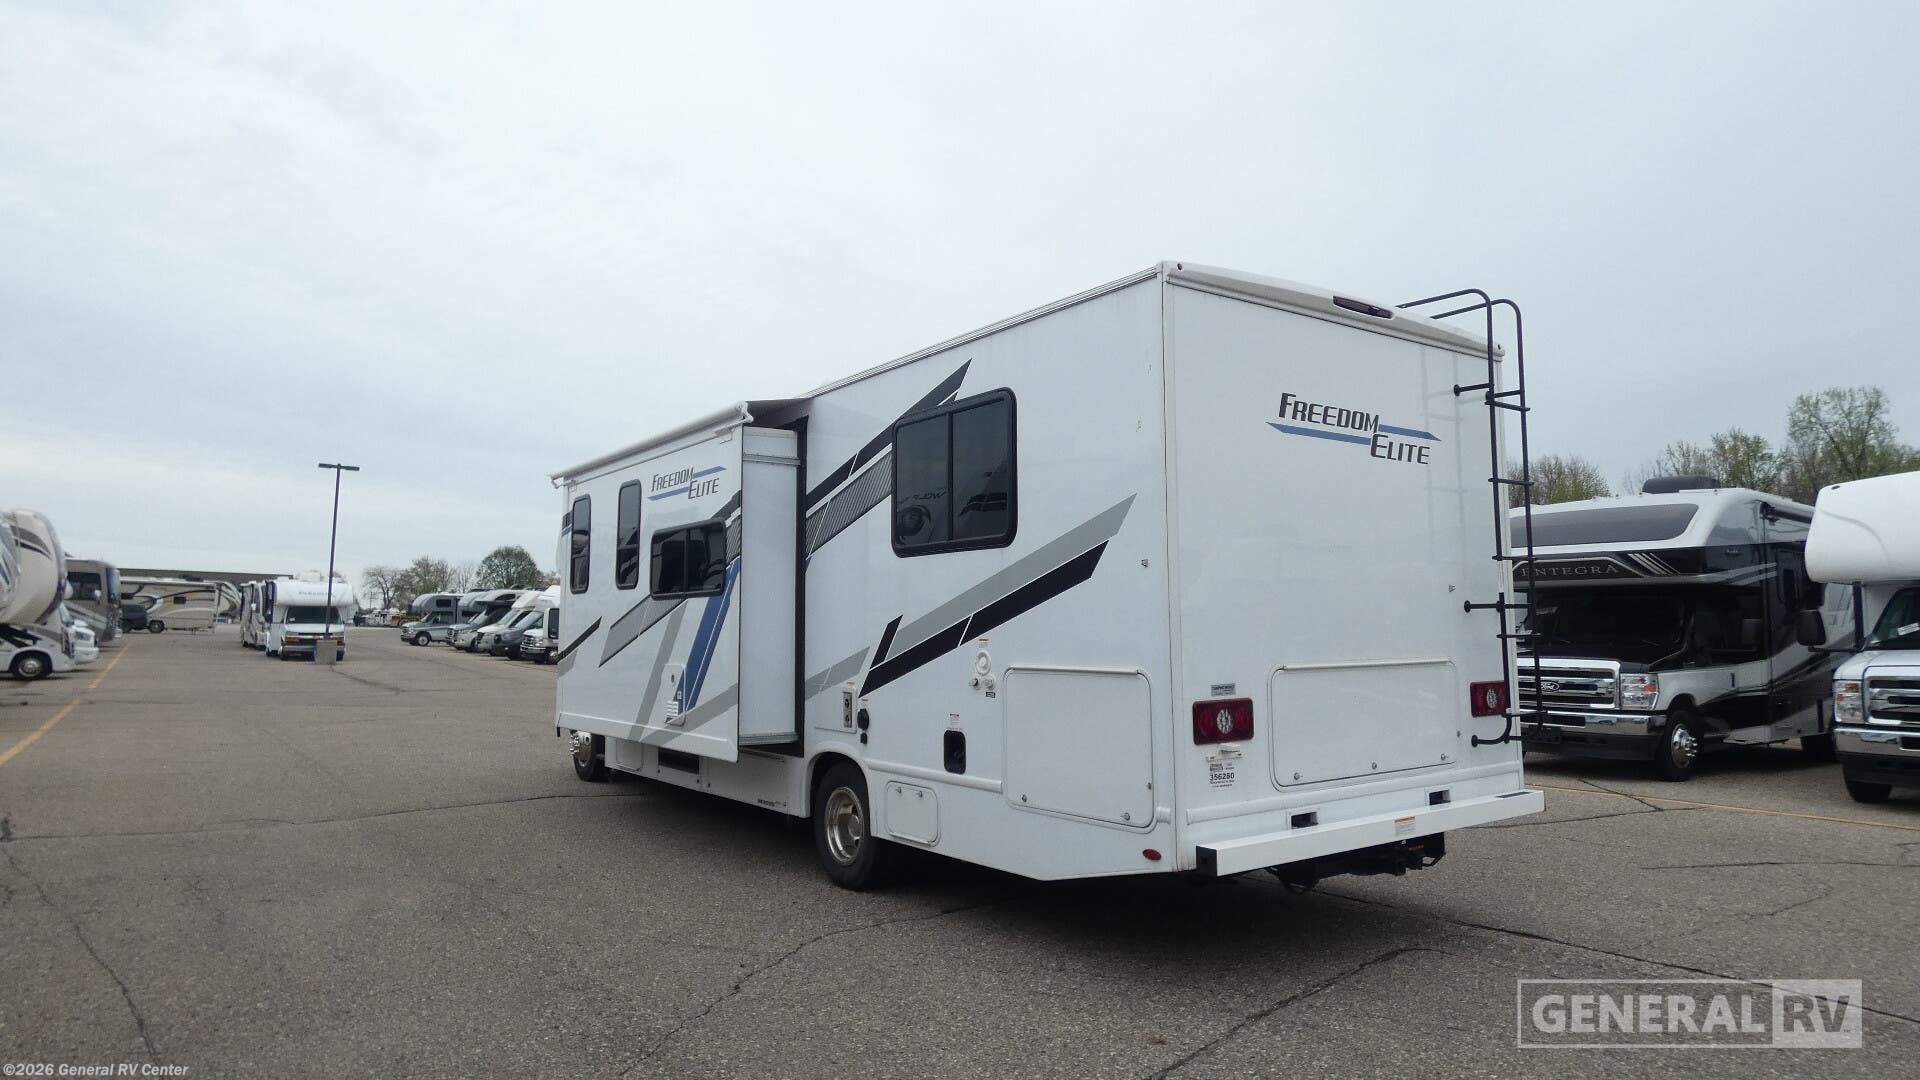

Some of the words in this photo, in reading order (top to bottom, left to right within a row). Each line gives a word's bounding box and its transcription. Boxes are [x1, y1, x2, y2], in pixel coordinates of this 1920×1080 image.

[1278, 392, 1380, 433] FREEDOM
[1370, 433, 1431, 465] ELITE
[651, 467, 694, 492] FREEDOM
[688, 478, 720, 499] ELITE
